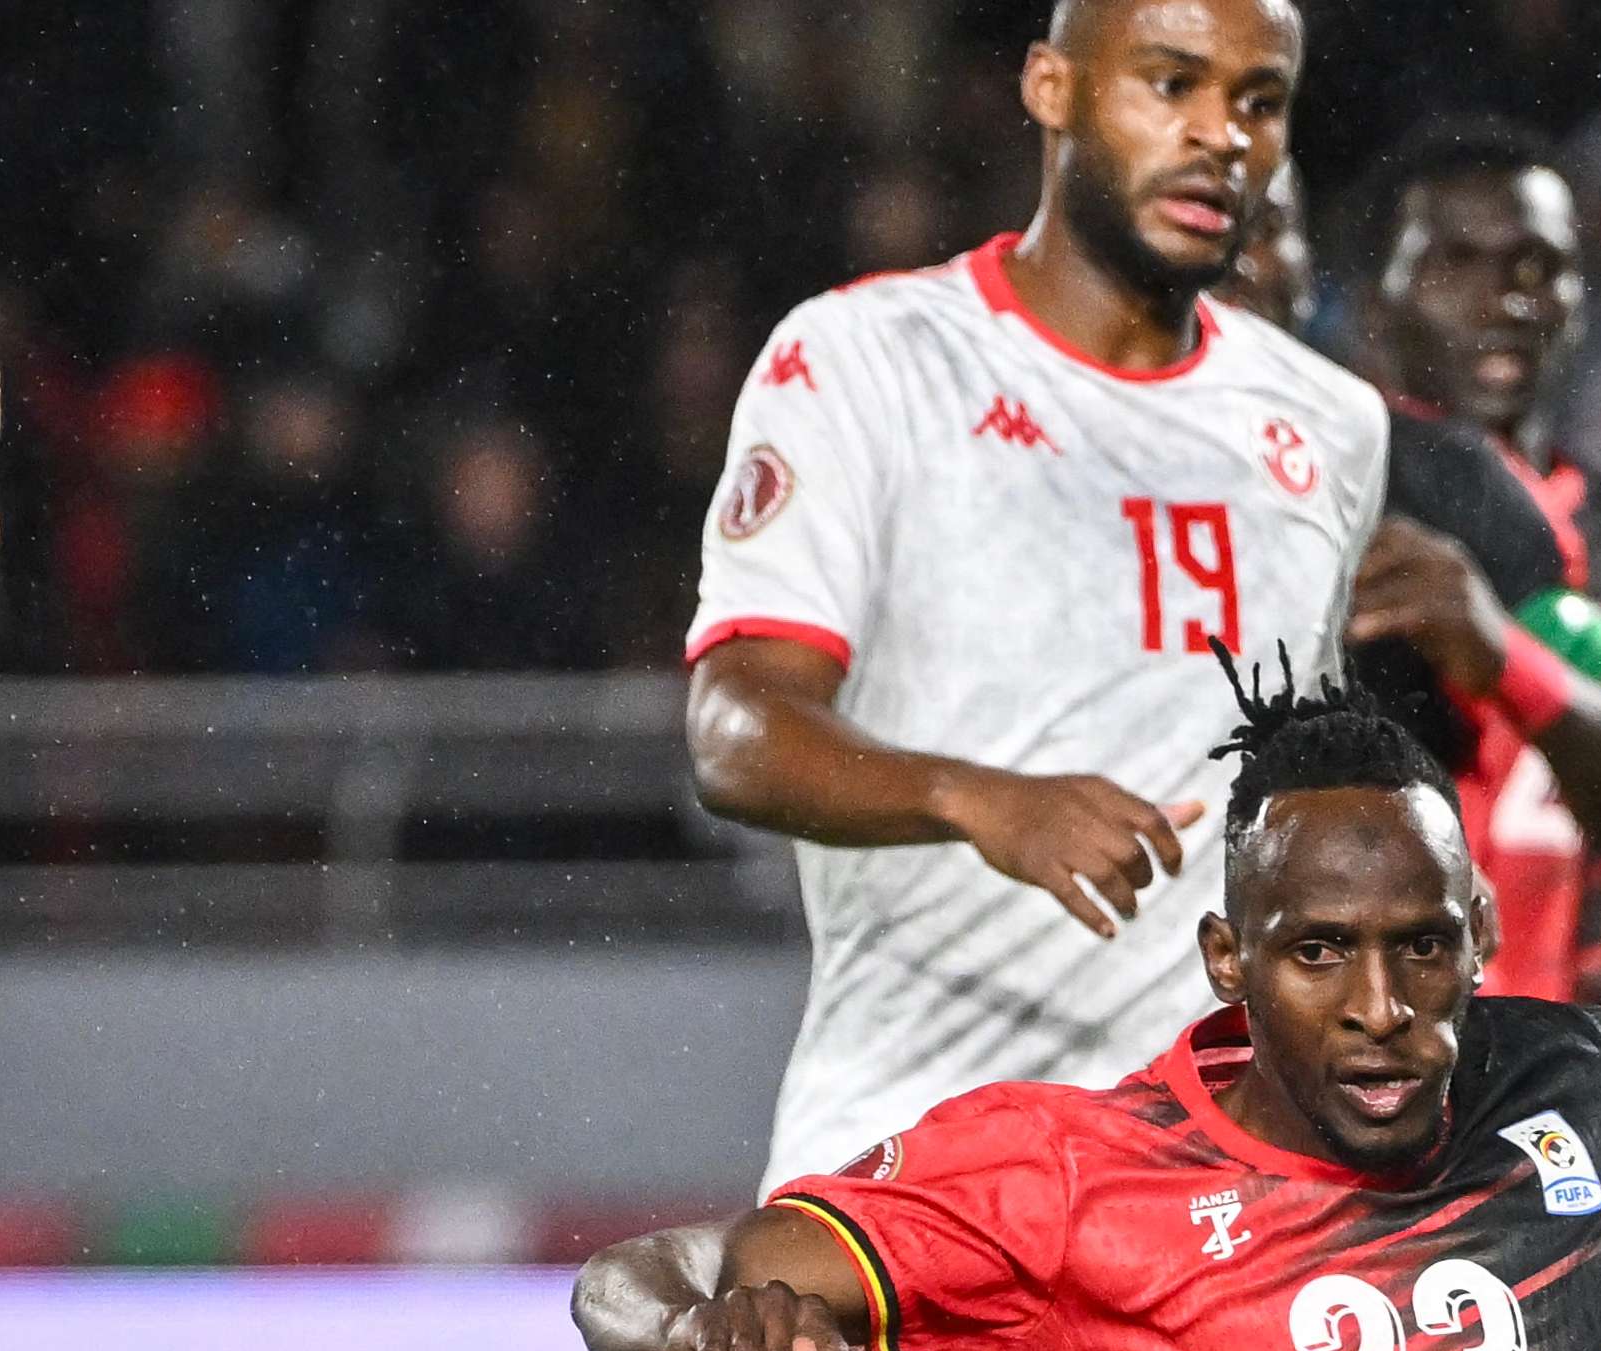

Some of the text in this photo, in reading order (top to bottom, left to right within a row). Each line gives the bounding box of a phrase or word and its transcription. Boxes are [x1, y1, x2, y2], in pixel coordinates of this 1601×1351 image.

[1121, 497, 1241, 656] 19
[1188, 1189, 1239, 1210] JANZI
[1555, 1185, 1593, 1203] FUFA
